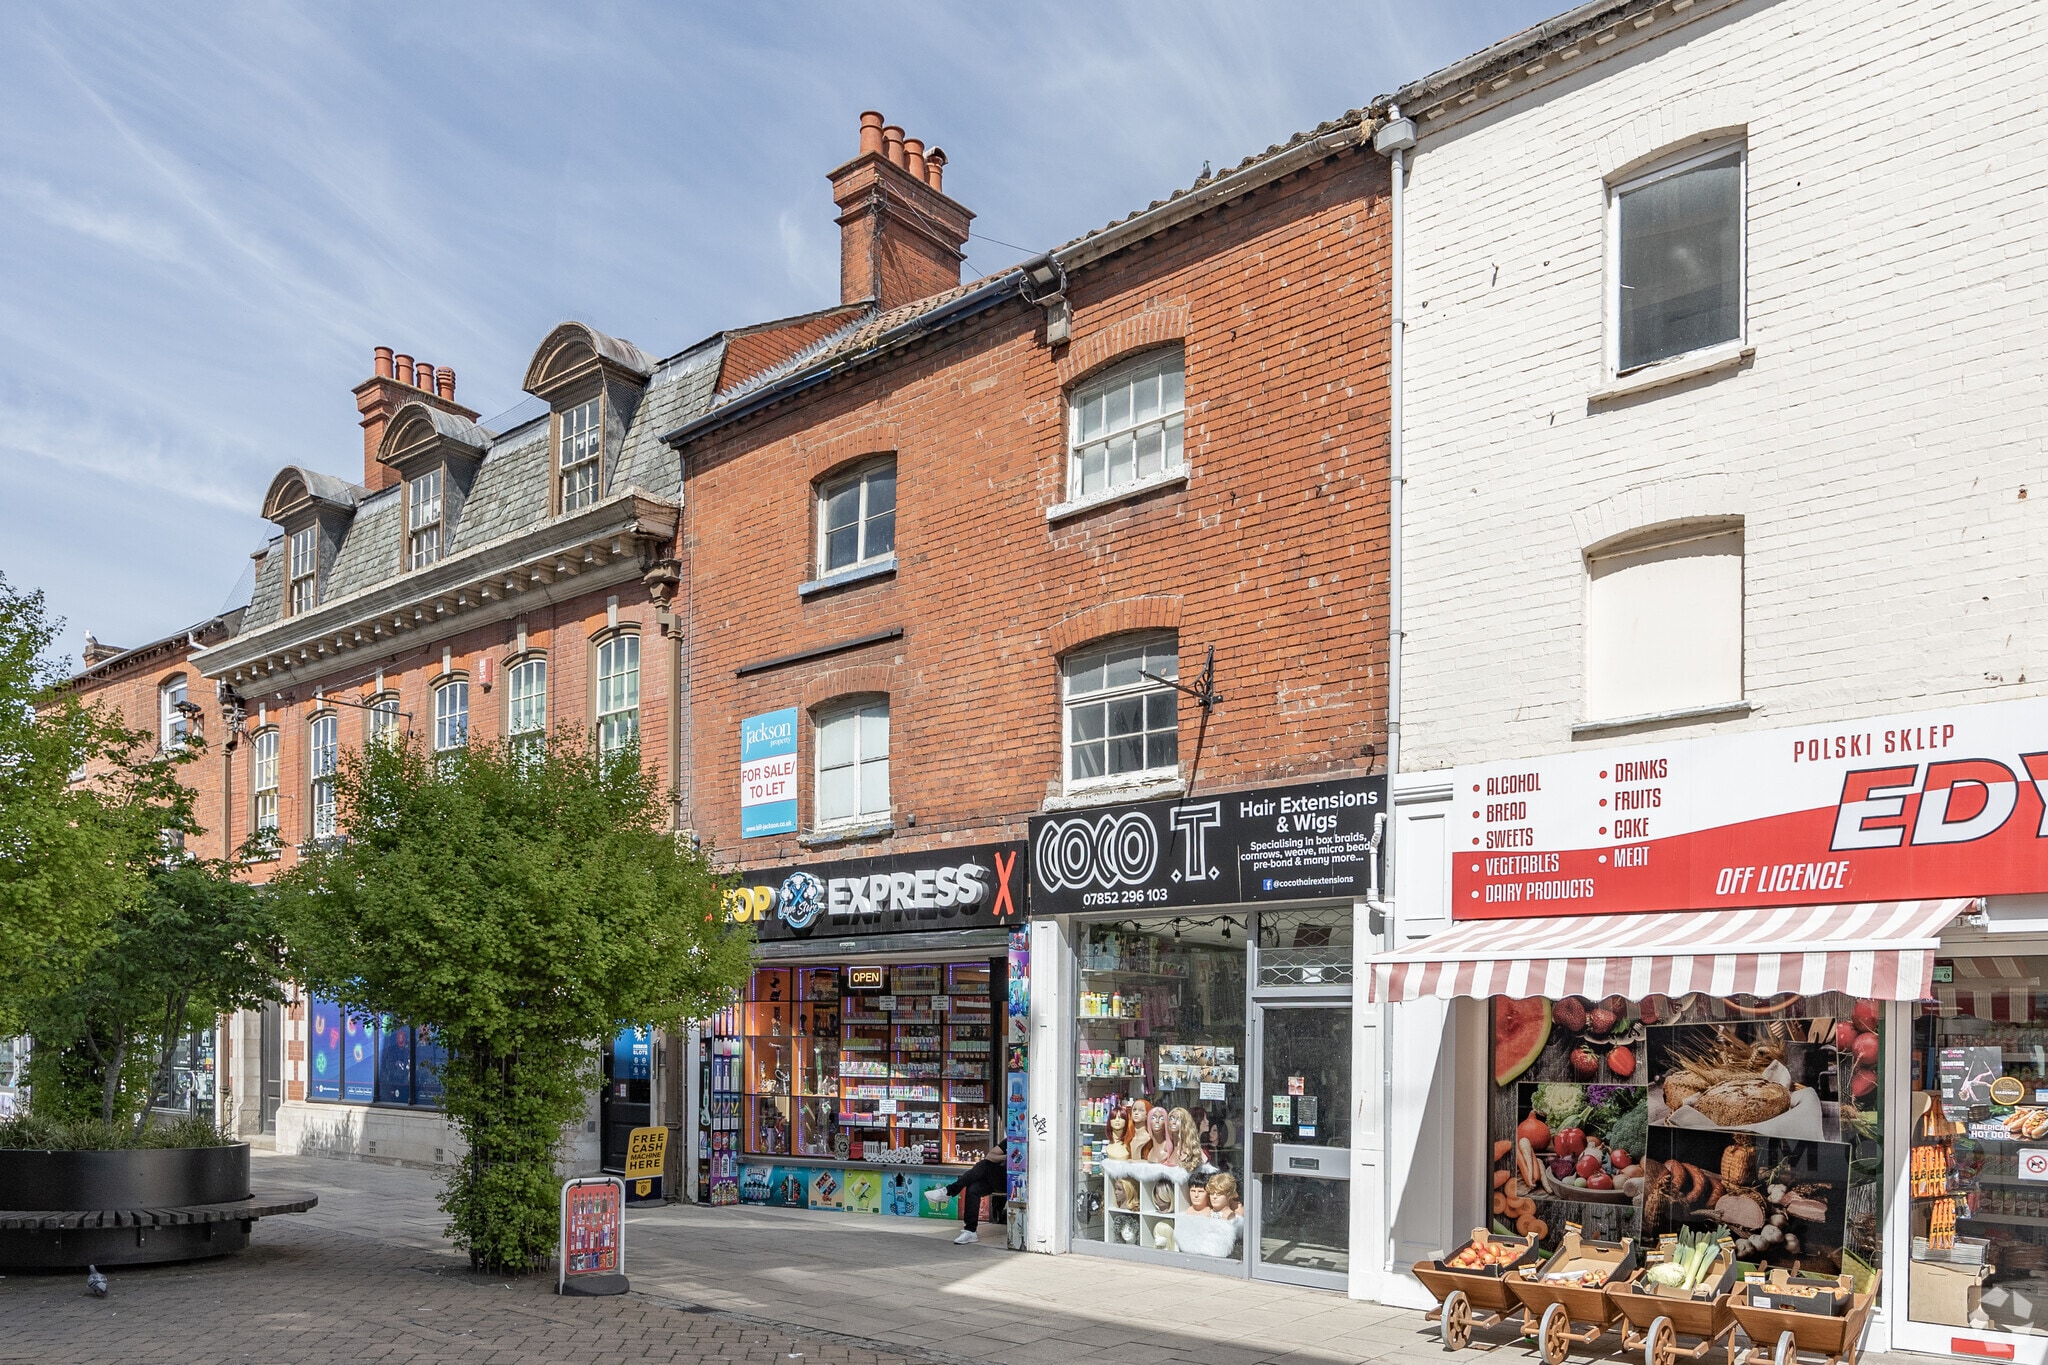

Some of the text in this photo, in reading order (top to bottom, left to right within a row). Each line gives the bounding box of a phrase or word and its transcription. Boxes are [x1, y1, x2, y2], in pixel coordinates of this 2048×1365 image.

[746, 722, 791, 754] jackson
[1794, 724, 1955, 763] POLSKI SKLEP
[742, 761, 796, 783] FOR SALE/
[1615, 758, 1668, 783] DRINKS
[750, 781, 785, 799] TO LET
[1487, 773, 1541, 796] ALCOHOL
[1240, 791, 1378, 818] Hair Extensions
[1614, 788, 1661, 811] FRUITS
[1487, 801, 1526, 823] BREAD
[1276, 813, 1337, 833] & Wigs
[1614, 818, 1649, 839] CAKE
[1250, 832, 1367, 851] Specialising in box braids,
[1486, 827, 1533, 849] SWEETS
[1036, 812, 1159, 893] COCO
[1240, 841, 1371, 861] cornrows, weave, micro bead
[1613, 847, 1650, 868] MEAT
[1253, 854, 1364, 871] pre-bond & many more...
[1485, 853, 1560, 877] VEGETABLES
[1273, 875, 1354, 888] @cocothairextensions
[1715, 861, 1850, 895] OFF LICENCE
[828, 863, 984, 915] EXPRESS
[1083, 888, 1168, 906] 07852 296 103
[1485, 878, 1594, 903] DAIRY PRODUCTS
[853, 972, 879, 982] OPEN
[633, 1132, 665, 1144] FREE
[1971, 1123, 2011, 1132] AMERICAN
[1971, 1130, 2011, 1139] HOT DOG
[630, 1151, 661, 1160] MACHINE
[632, 1143, 663, 1153] CASH
[629, 1158, 661, 1171] HERE
